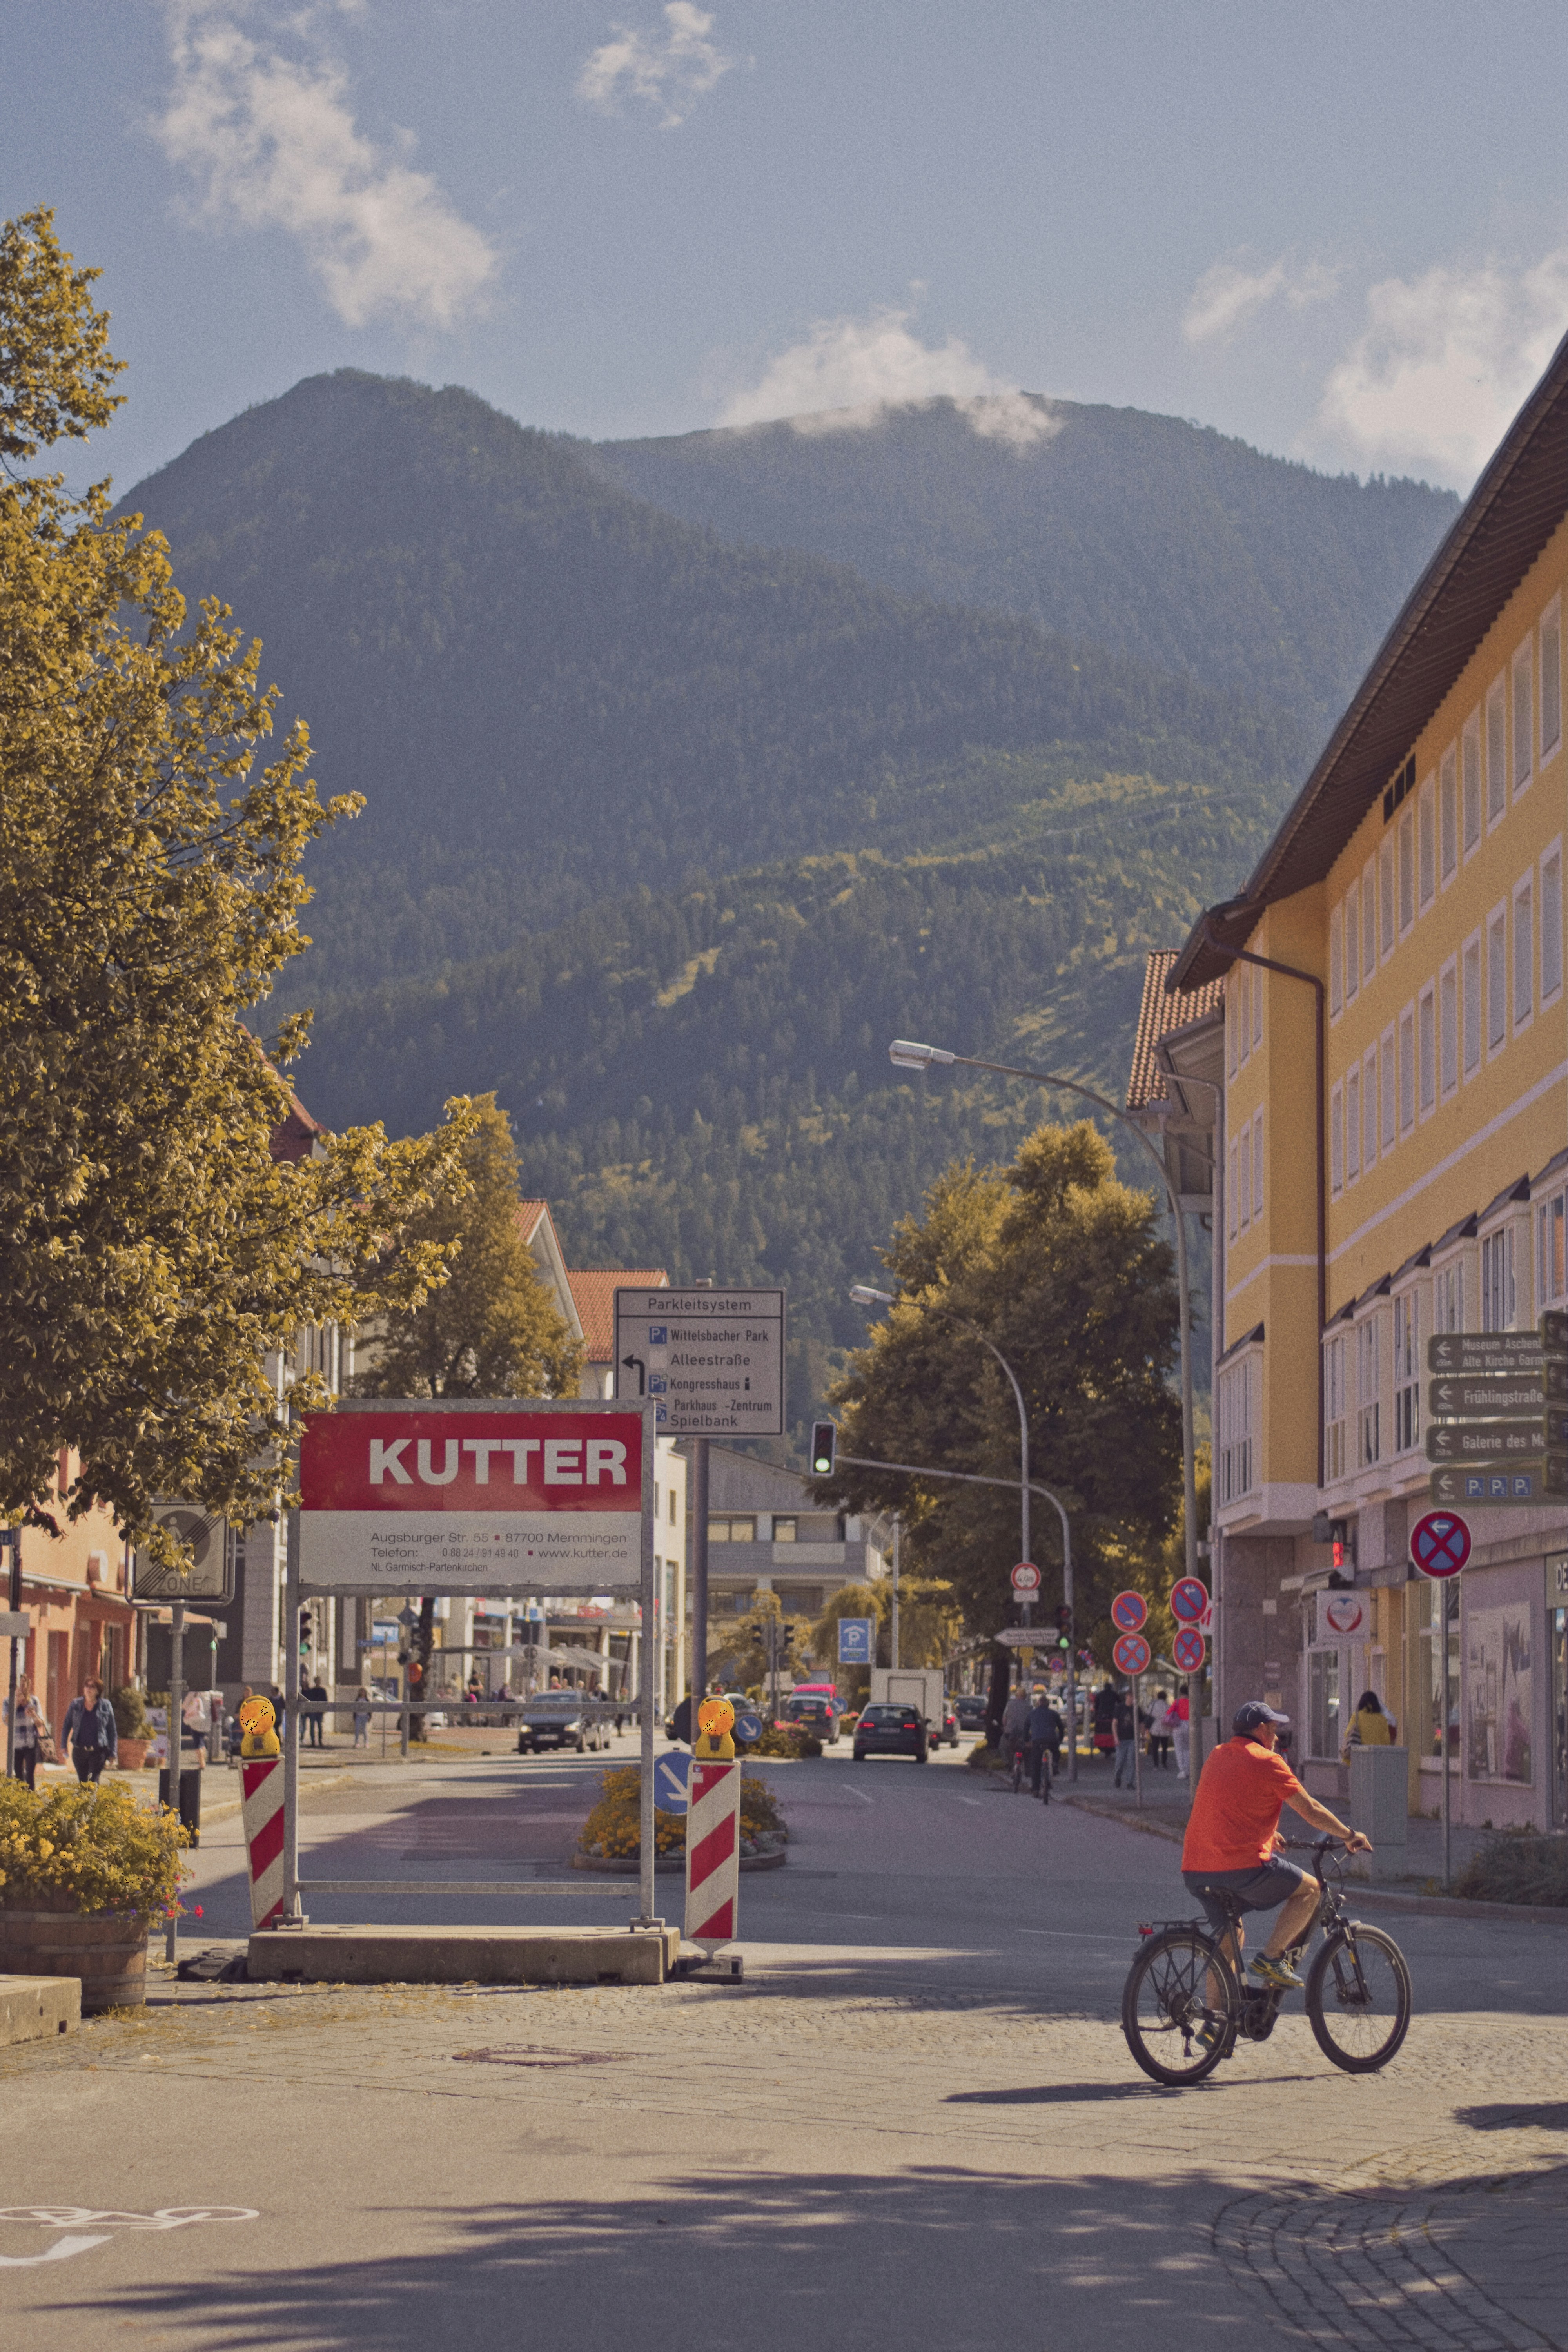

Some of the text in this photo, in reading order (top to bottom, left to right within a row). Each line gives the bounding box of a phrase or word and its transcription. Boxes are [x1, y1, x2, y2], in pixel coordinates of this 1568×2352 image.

[648, 1298, 751, 1312] Parkleitsystem
[671, 1330, 740, 1341] Wittelsbacher
[746, 1330, 768, 1341] Park
[1462, 1339, 1500, 1351] Museum
[671, 1354, 750, 1365] Alleestraße
[1463, 1356, 1481, 1367] Alte
[1485, 1355, 1514, 1367] Kirche
[670, 1378, 740, 1392] Kongresshaus
[1464, 1389, 1543, 1406] Frühlingstraße
[675, 1399, 717, 1410] Parkhaus
[671, 1415, 737, 1428] Spielbank
[1463, 1435, 1501, 1449] Galerie
[1507, 1434, 1526, 1447] des
[369, 1439, 627, 1485] KUTTER
[371, 1533, 626, 1544] Augsburger Str. 55 87700 Memmingen
[371, 1548, 418, 1557] Telefon:
[538, 1548, 628, 1558] www.kutter.de
[371, 1562, 488, 1572] NL Garmisch-Partenkirchen
[157, 1577, 202, 1592] ZONE
